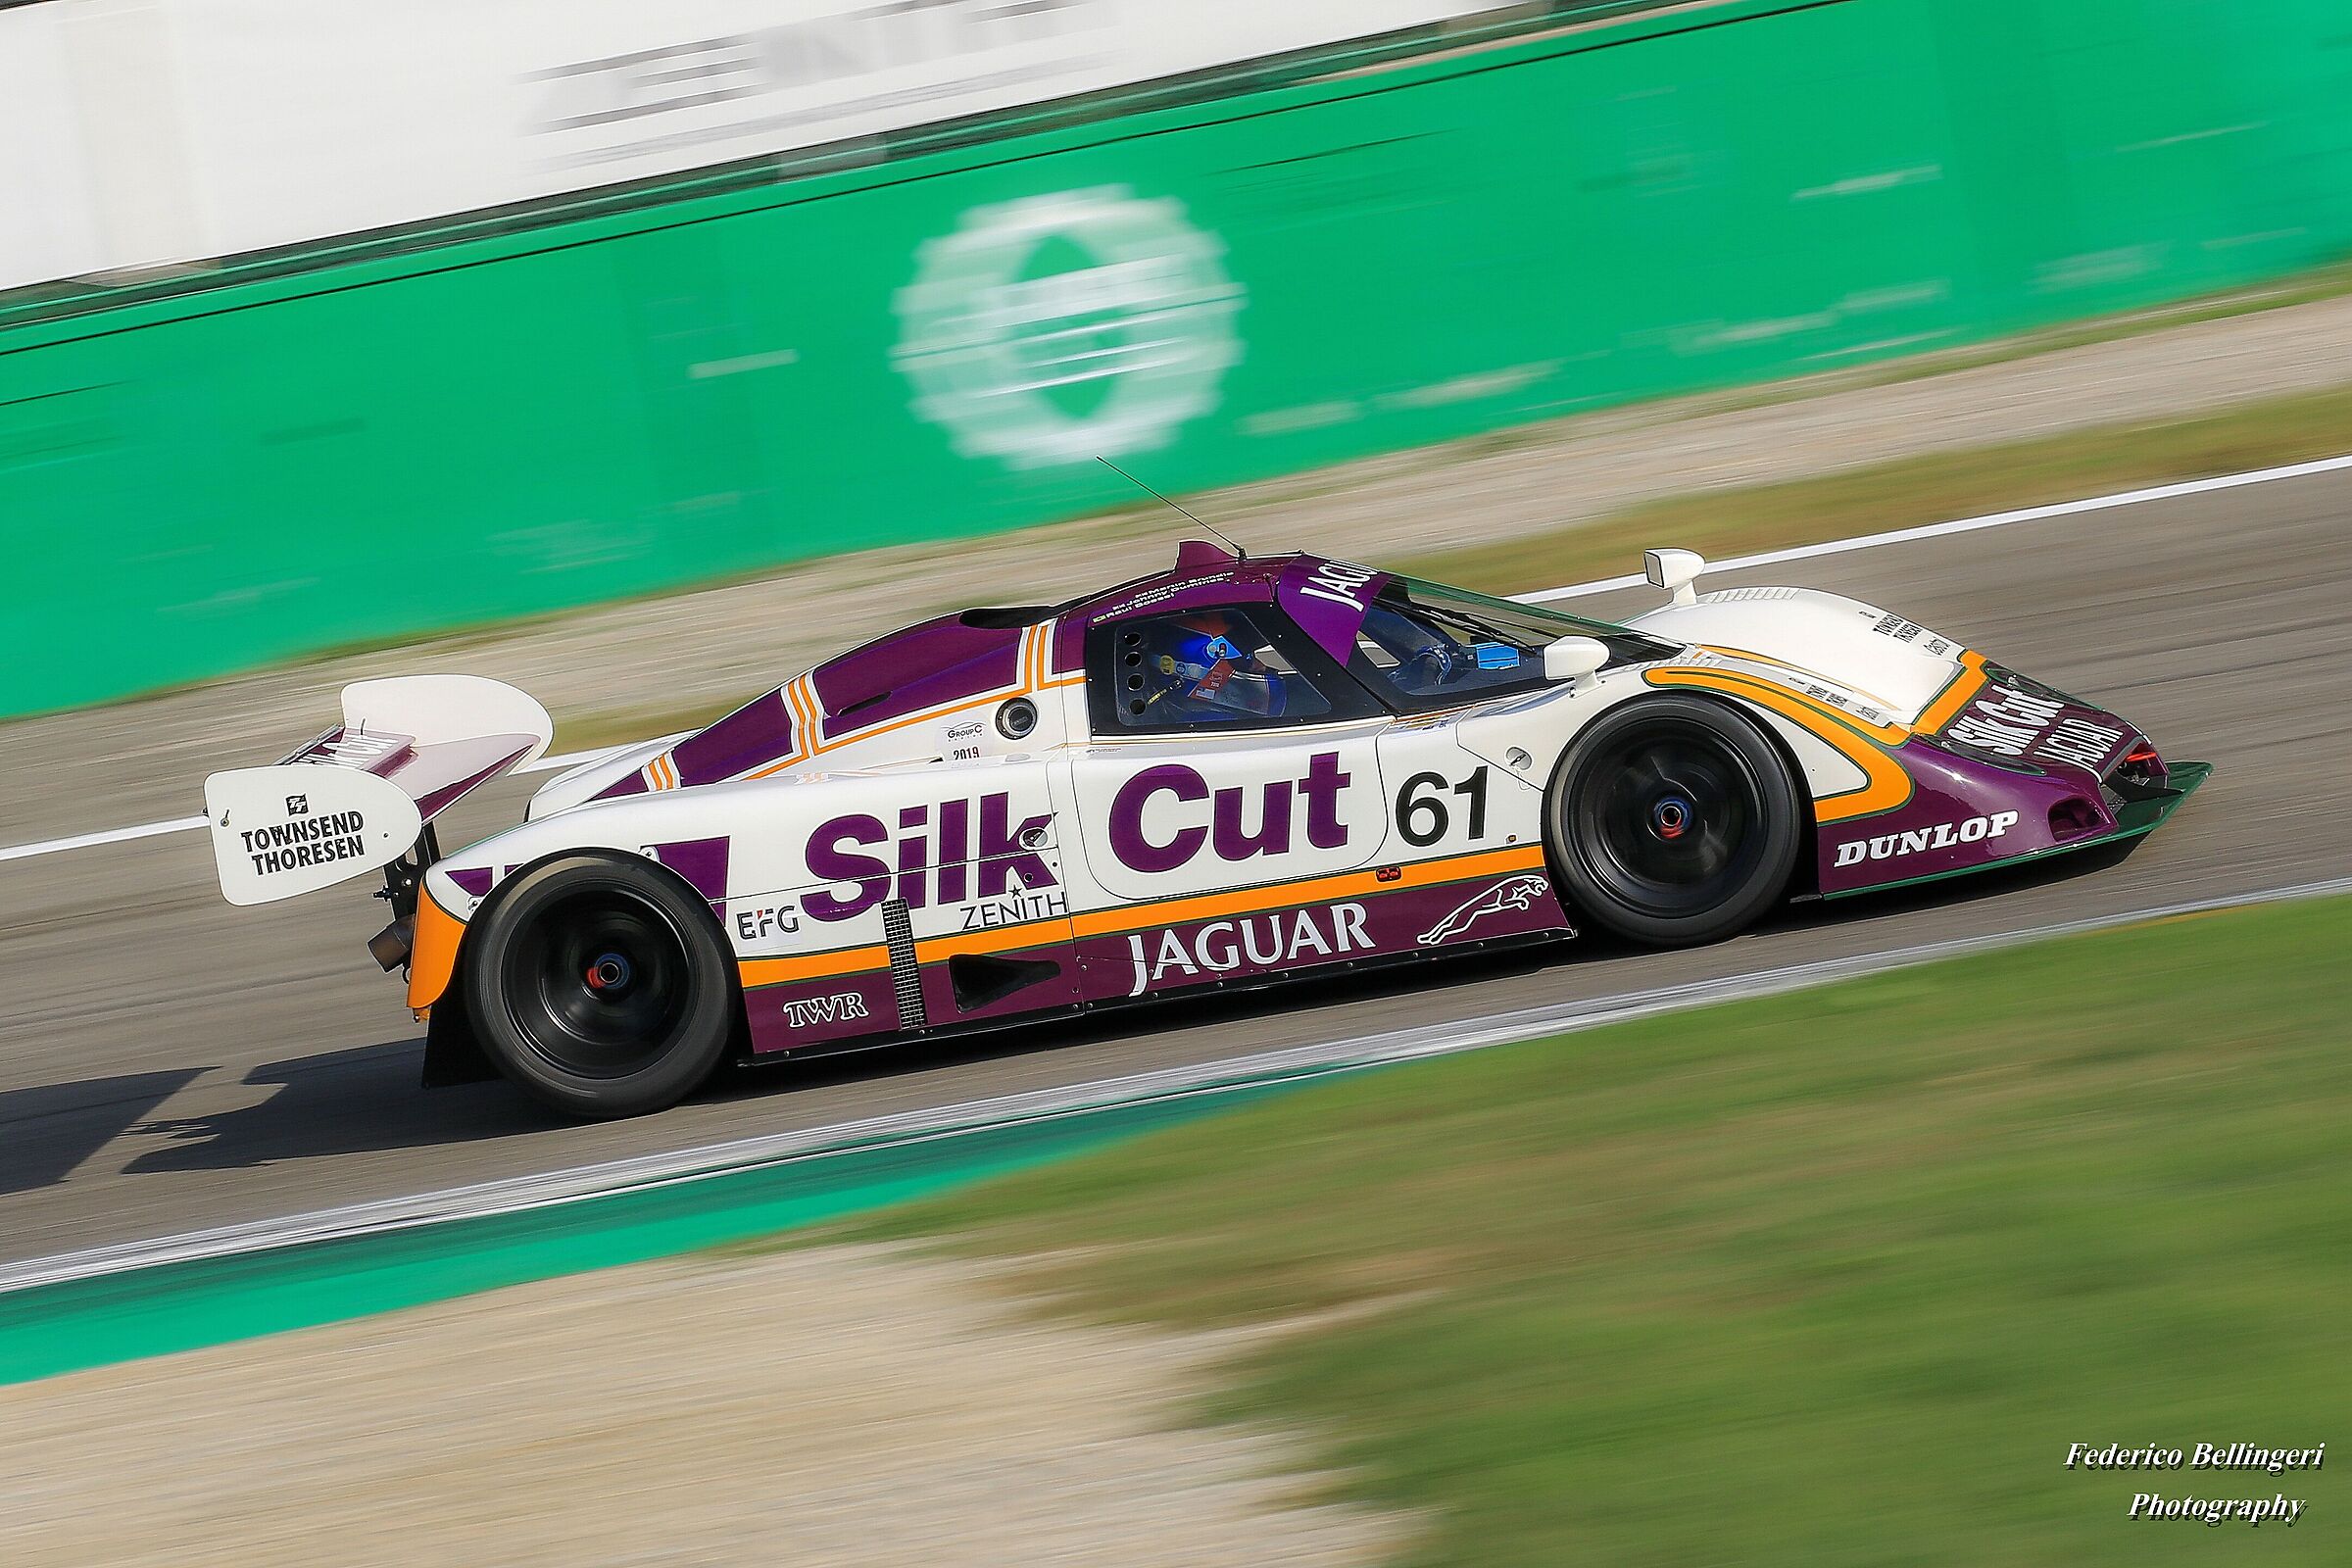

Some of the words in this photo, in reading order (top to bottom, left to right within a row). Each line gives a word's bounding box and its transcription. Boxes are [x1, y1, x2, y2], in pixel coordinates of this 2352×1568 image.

[1975, 684, 2065, 728] Cut
[953, 746, 981, 761] 2019
[1946, 714, 2040, 757] Silk
[2033, 718, 2125, 783] JAGUAR
[1396, 765, 1489, 848] 61
[241, 810, 365, 853] TOWNSEND
[801, 792, 1059, 922] Silk
[1108, 751, 1351, 874] Cut
[1834, 810, 2019, 867] DUNLOP
[252, 834, 366, 876] THORESEN
[738, 904, 801, 942] EFG
[959, 891, 1068, 931] ZENITH
[1128, 903, 1376, 997] JAGUAR
[783, 991, 870, 1029] TWR
